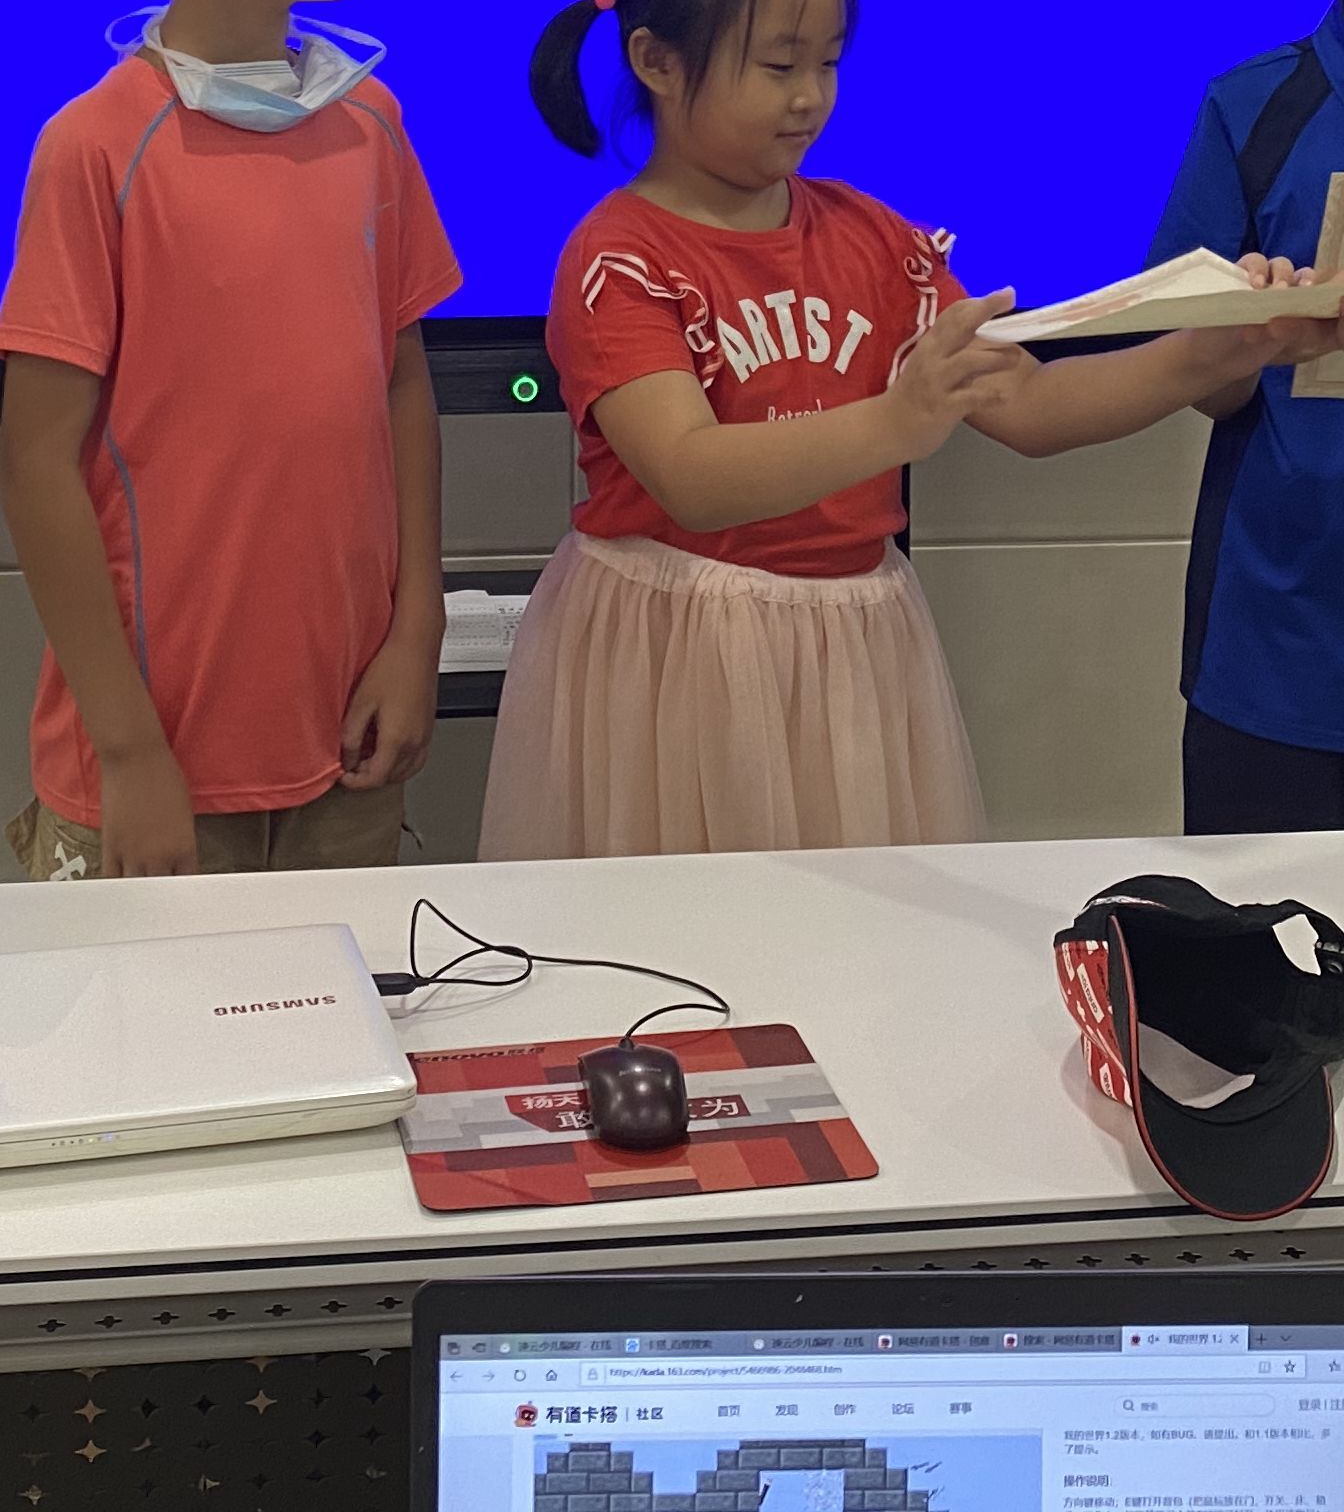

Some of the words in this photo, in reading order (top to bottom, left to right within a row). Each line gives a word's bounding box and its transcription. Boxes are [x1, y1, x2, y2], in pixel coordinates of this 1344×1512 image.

[213, 994, 337, 1017] SAMSUNG
[521, 1092, 583, 1110] 扬天
[717, 1404, 741, 1418] 首页
[775, 1403, 799, 1417] 发现
[833, 1403, 857, 1416] 创作
[891, 1402, 915, 1416] 论坛
[949, 1401, 973, 1415] 赛事
[1298, 1398, 1322, 1412] 登录
[545, 1405, 618, 1424] 有道卡搭
[636, 1407, 664, 1421] 社区
